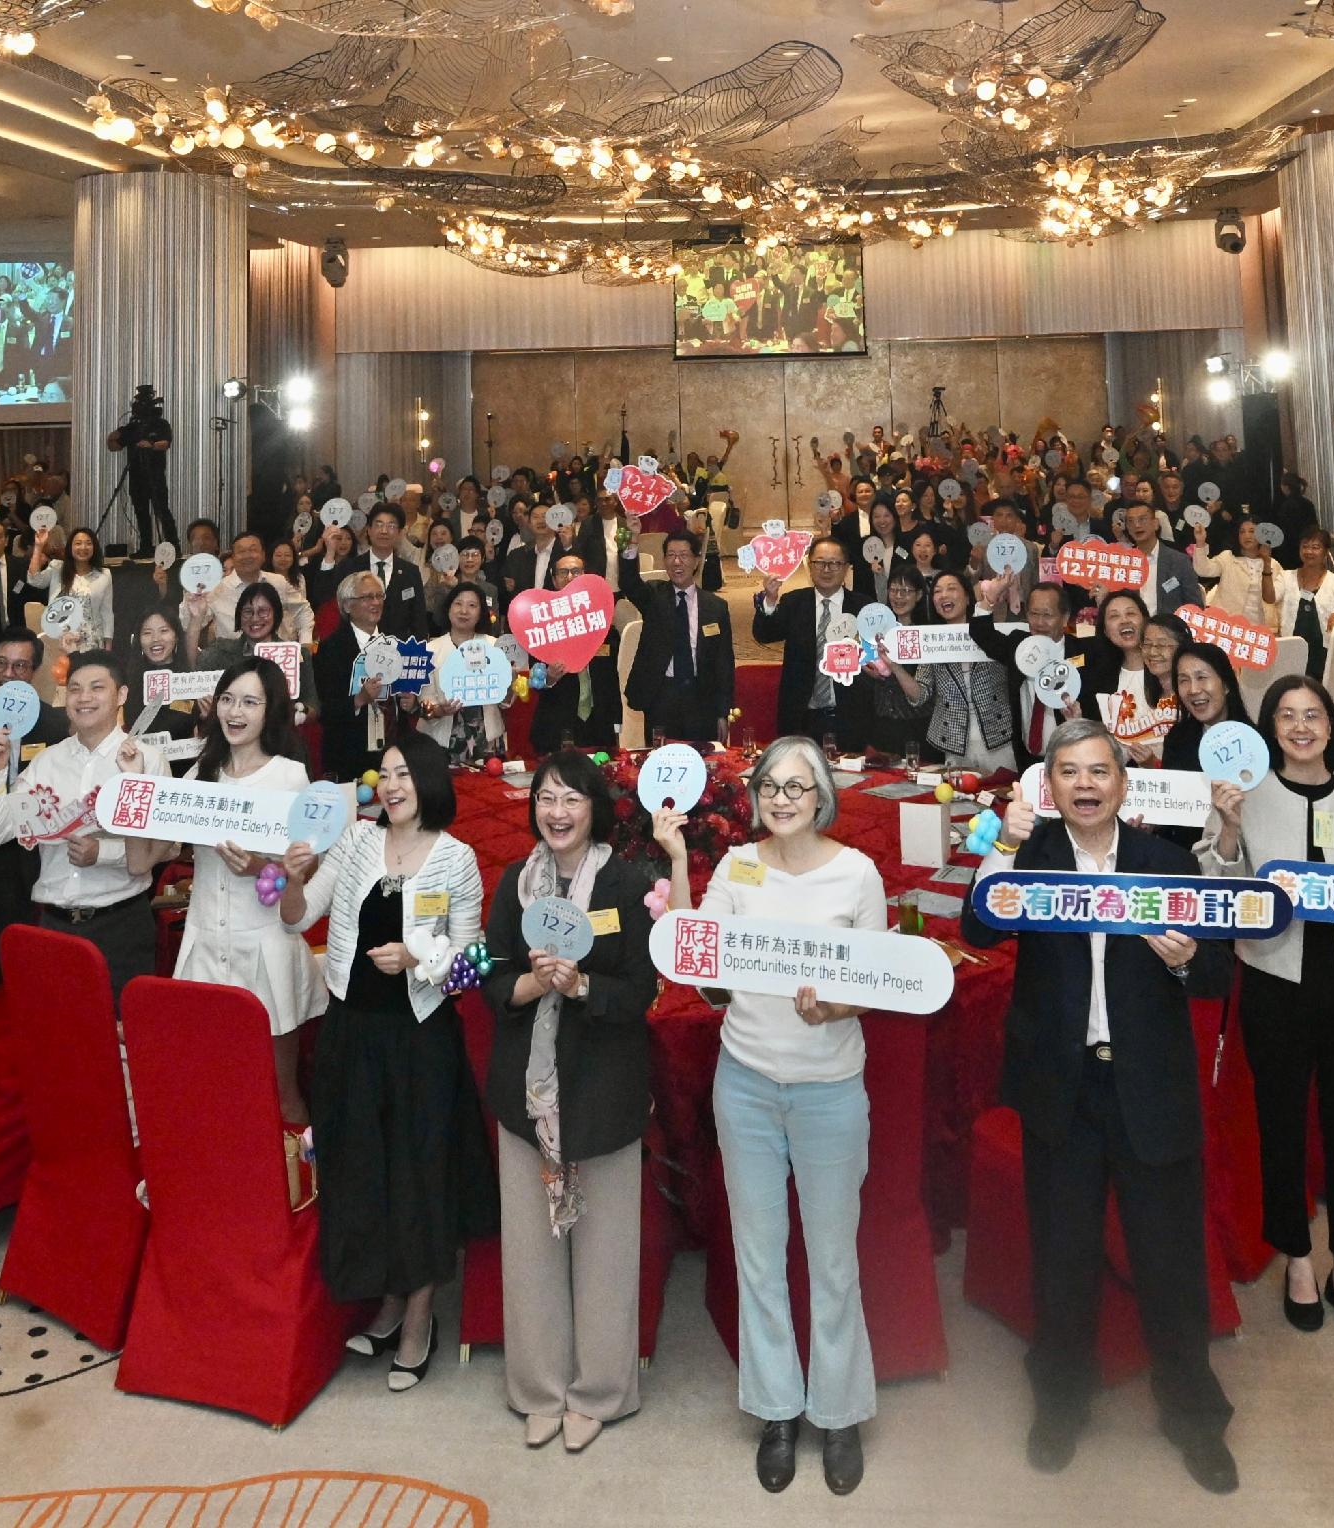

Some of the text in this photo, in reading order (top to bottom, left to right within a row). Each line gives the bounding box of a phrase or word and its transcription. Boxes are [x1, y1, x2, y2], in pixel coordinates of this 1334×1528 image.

[1063, 547, 1143, 568] 社福界功能組別
[530, 590, 591, 624] 社福界
[525, 609, 607, 649] 功能組別
[1178, 609, 1271, 648] 社福界功能組別
[157, 790, 254, 815] 老有所為活動計劃
[1134, 796, 1145, 807] for
[1148, 797, 1162, 809] the
[1164, 797, 1194, 812] Elderly
[152, 808, 210, 827] Opportunities
[211, 815, 224, 828] for
[225, 817, 240, 830] the
[241, 818, 271, 836] Elderly
[989, 883, 1274, 928] 老有所為活動計劃
[724, 931, 851, 962] 老有所為活動計劃
[723, 953, 923, 993] Opportunities for the Elderly Project
